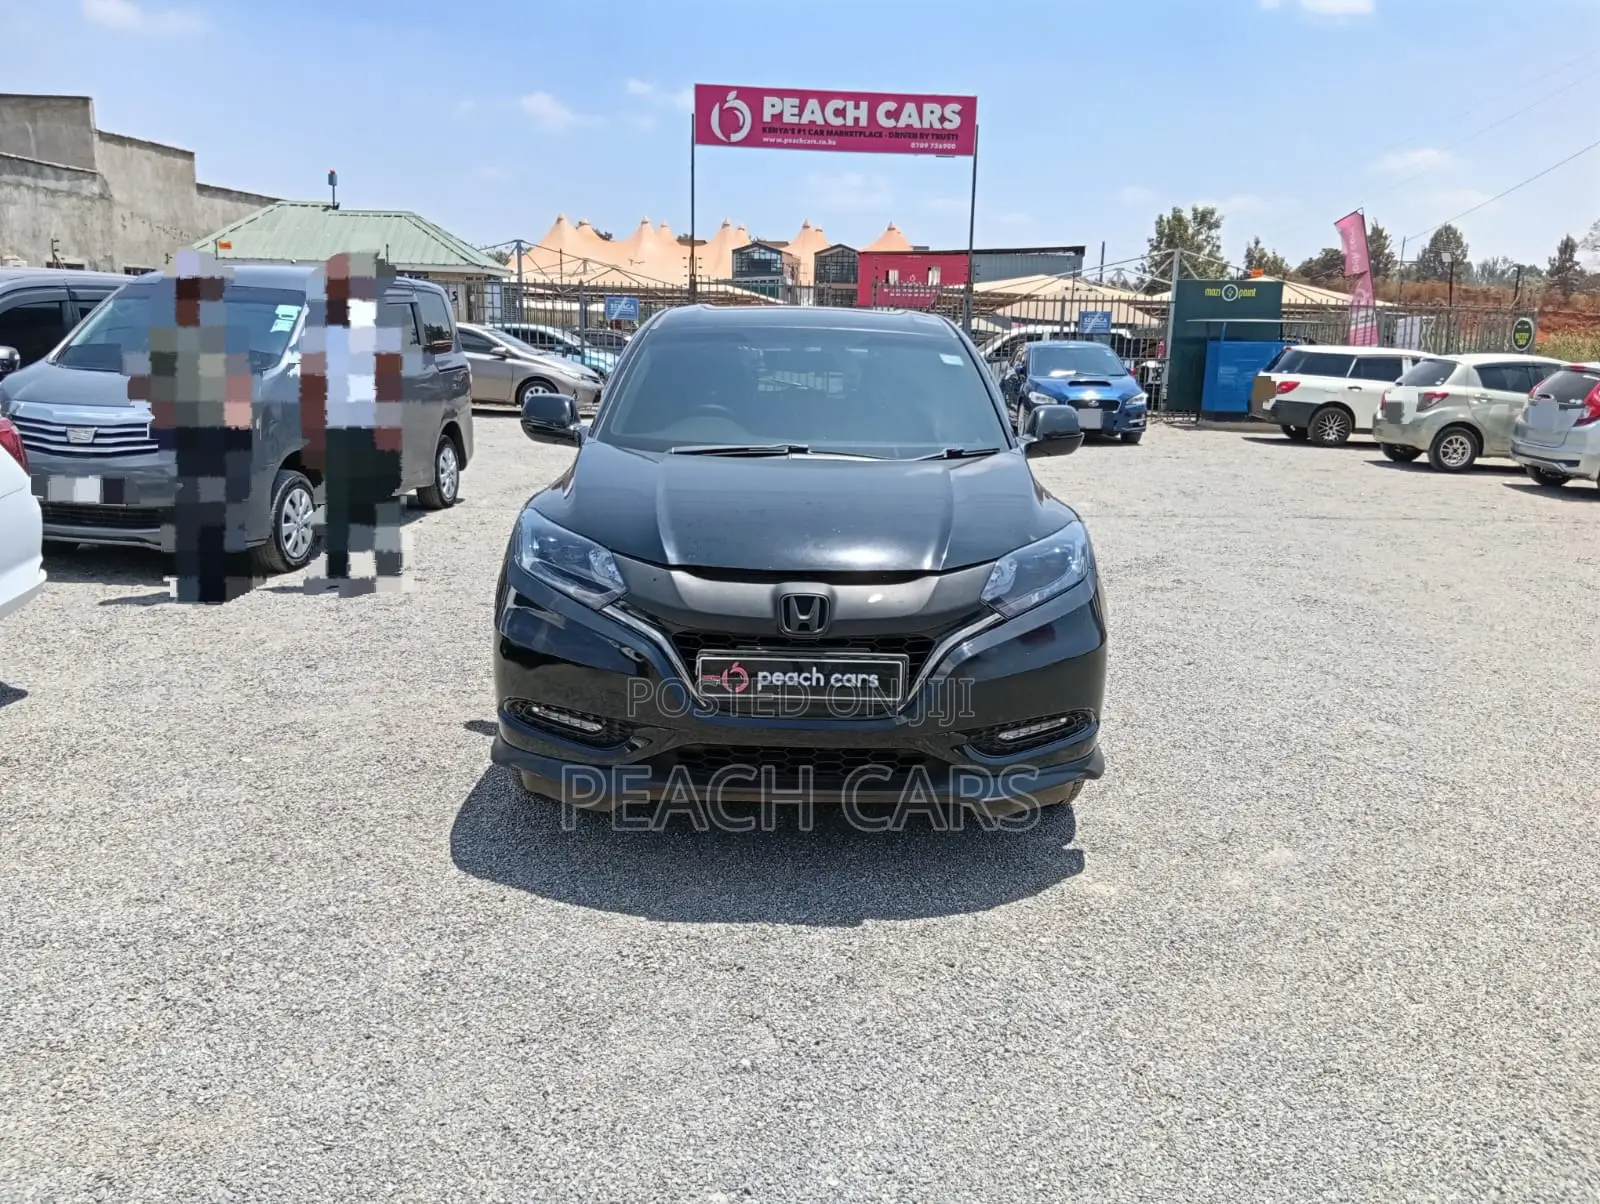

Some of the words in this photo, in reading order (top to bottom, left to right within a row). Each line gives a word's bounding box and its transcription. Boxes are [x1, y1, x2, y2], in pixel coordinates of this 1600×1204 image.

[762, 96, 868, 127] PEACH
[876, 101, 962, 130] CARS
[762, 126, 795, 135] KENYA'S
[808, 128, 825, 136] CAR
[825, 129, 883, 138] MARKETPLACE
[888, 131, 917, 139] DRIVEN
[1238, 287, 1257, 299] point
[757, 666, 825, 692] peach
[830, 672, 879, 688] cars
